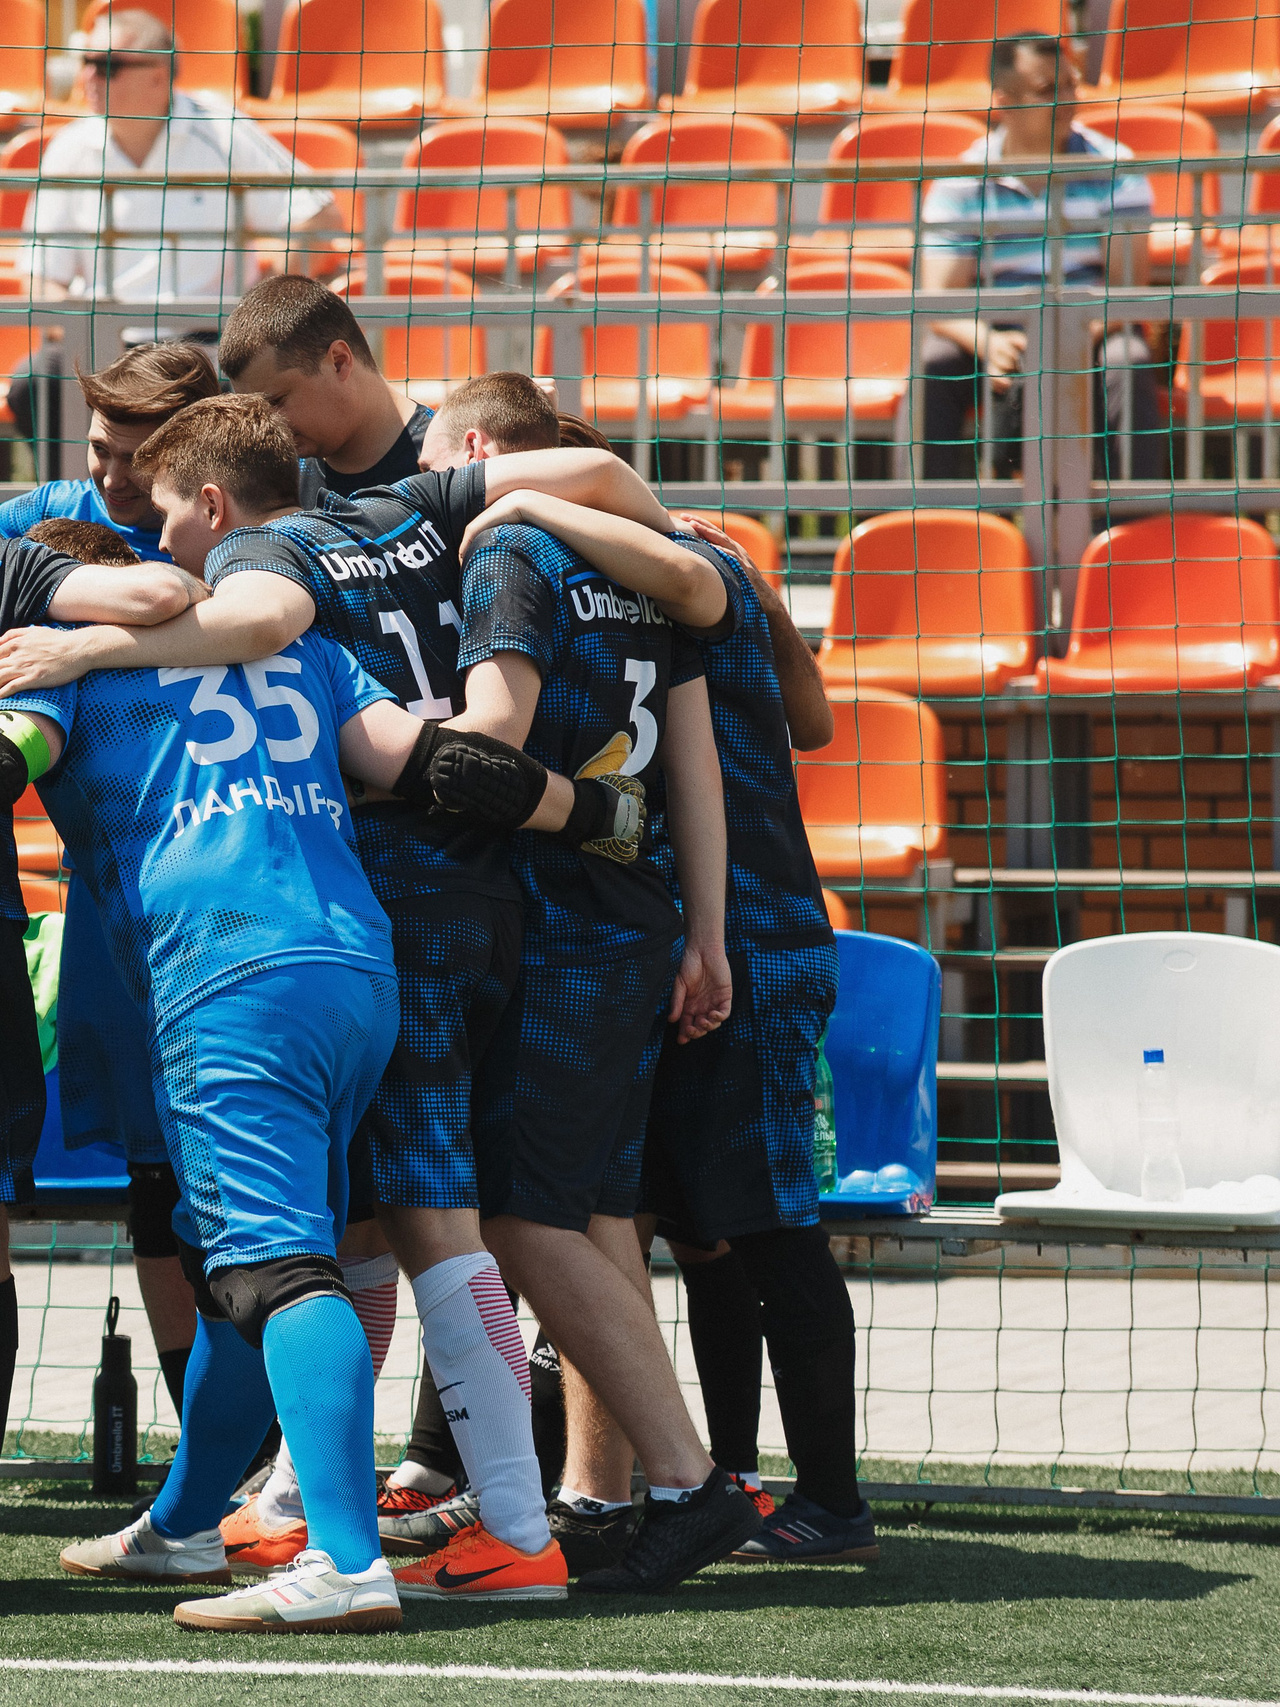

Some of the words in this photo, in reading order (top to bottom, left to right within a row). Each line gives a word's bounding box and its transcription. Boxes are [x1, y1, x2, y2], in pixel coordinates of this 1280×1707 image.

[157, 655, 320, 766] 35
[111, 1405, 123, 1418] IT
[111, 1420, 123, 1473] Umbrella
